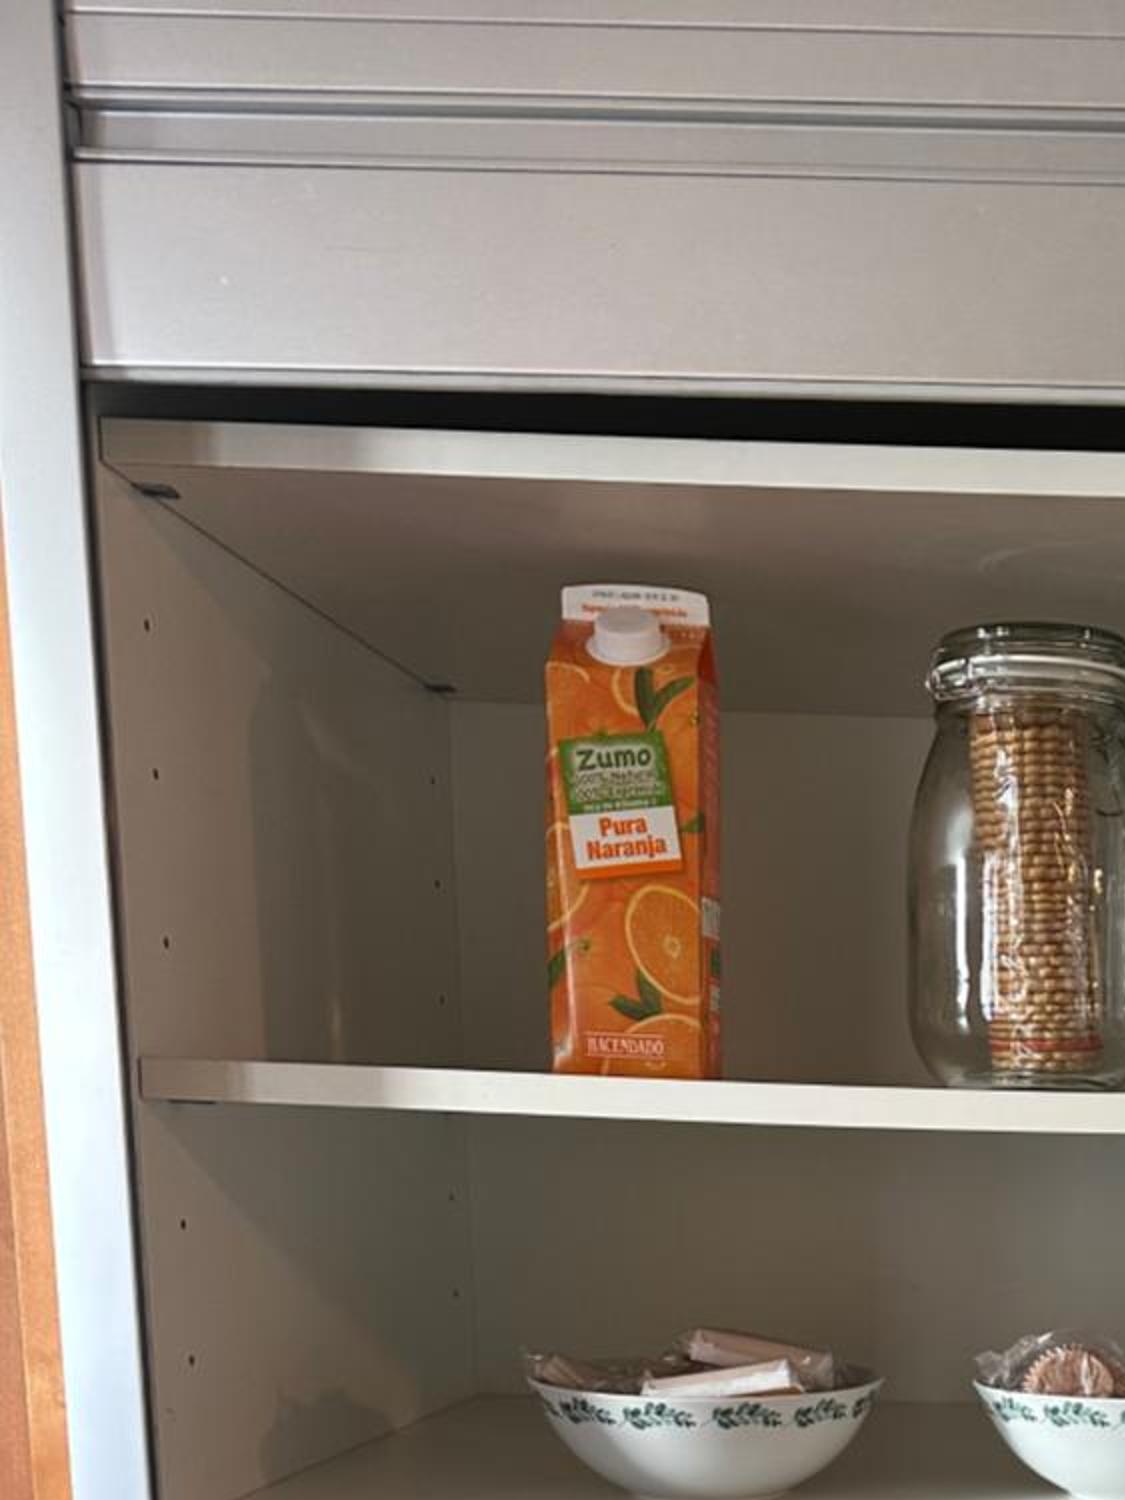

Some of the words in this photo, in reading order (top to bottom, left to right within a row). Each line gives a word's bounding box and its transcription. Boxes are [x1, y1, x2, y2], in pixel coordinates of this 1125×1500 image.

[576, 748, 652, 772] Zumo
[598, 816, 647, 837] Pura
[585, 835, 667, 861] Naranja
